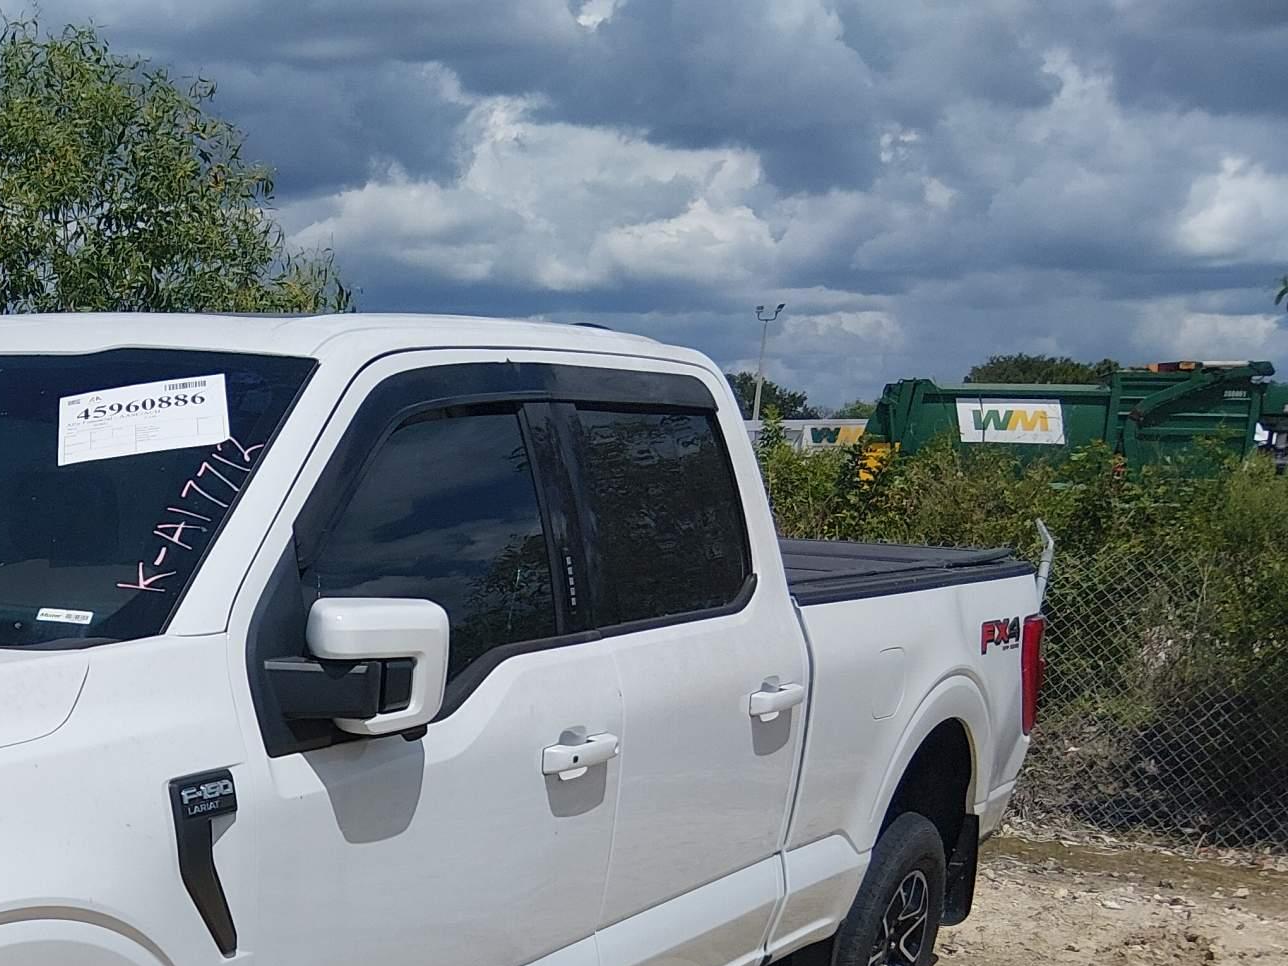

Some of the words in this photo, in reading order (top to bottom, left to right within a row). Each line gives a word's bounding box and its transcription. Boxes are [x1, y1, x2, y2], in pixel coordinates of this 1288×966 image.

[76, 391, 207, 420] 45960886
[972, 410, 1049, 431] WM
[981, 616, 1020, 655] FX4
[181, 780, 233, 804] F-150
[187, 801, 220, 815] LARIAT
